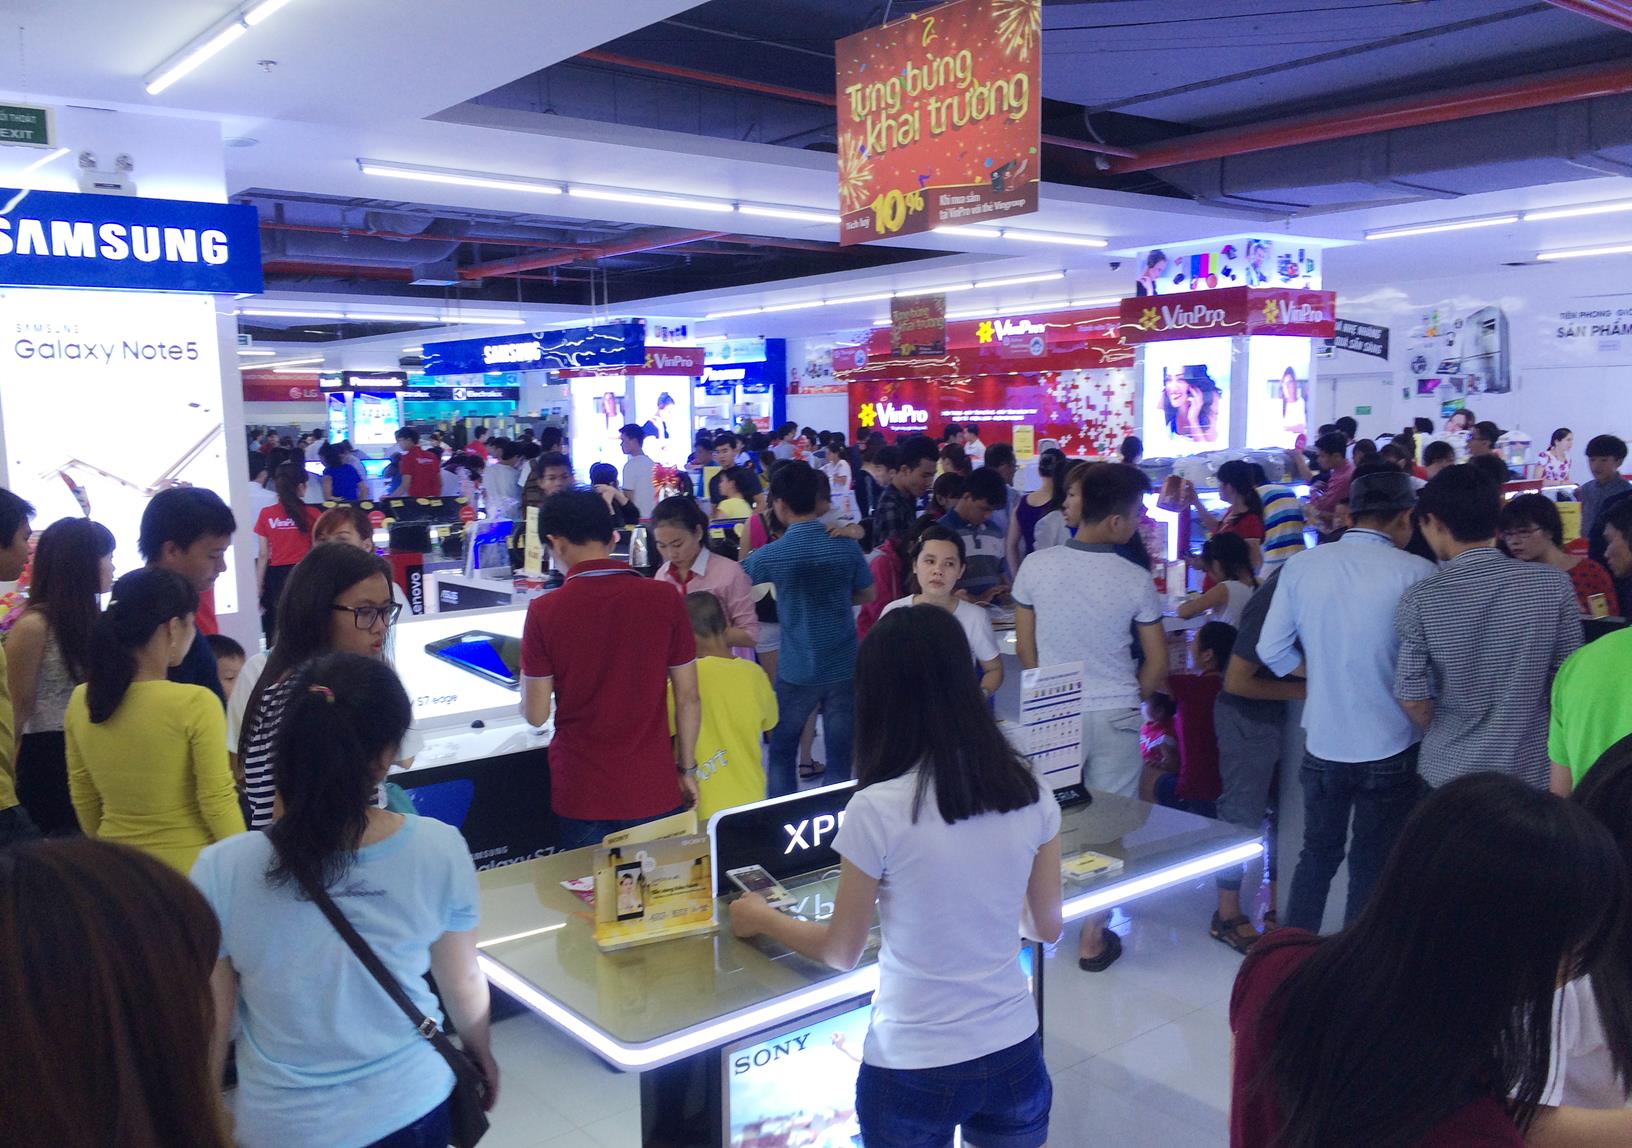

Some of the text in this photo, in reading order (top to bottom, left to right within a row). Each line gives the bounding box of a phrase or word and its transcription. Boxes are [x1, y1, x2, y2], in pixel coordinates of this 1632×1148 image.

[845, 49, 972, 122] Tưng bừng
[866, 72, 1029, 157] khai trường
[871, 189, 924, 235] 10%
[1160, 304, 1226, 330] VinPro
[1279, 299, 1323, 324] VinPro
[14, 338, 199, 365] Galaxy Note5
[653, 353, 694, 369] VinPro
[876, 402, 928, 427] VinPro
[417, 694, 458, 706] S7 edge
[734, 1033, 811, 1076] SONY
